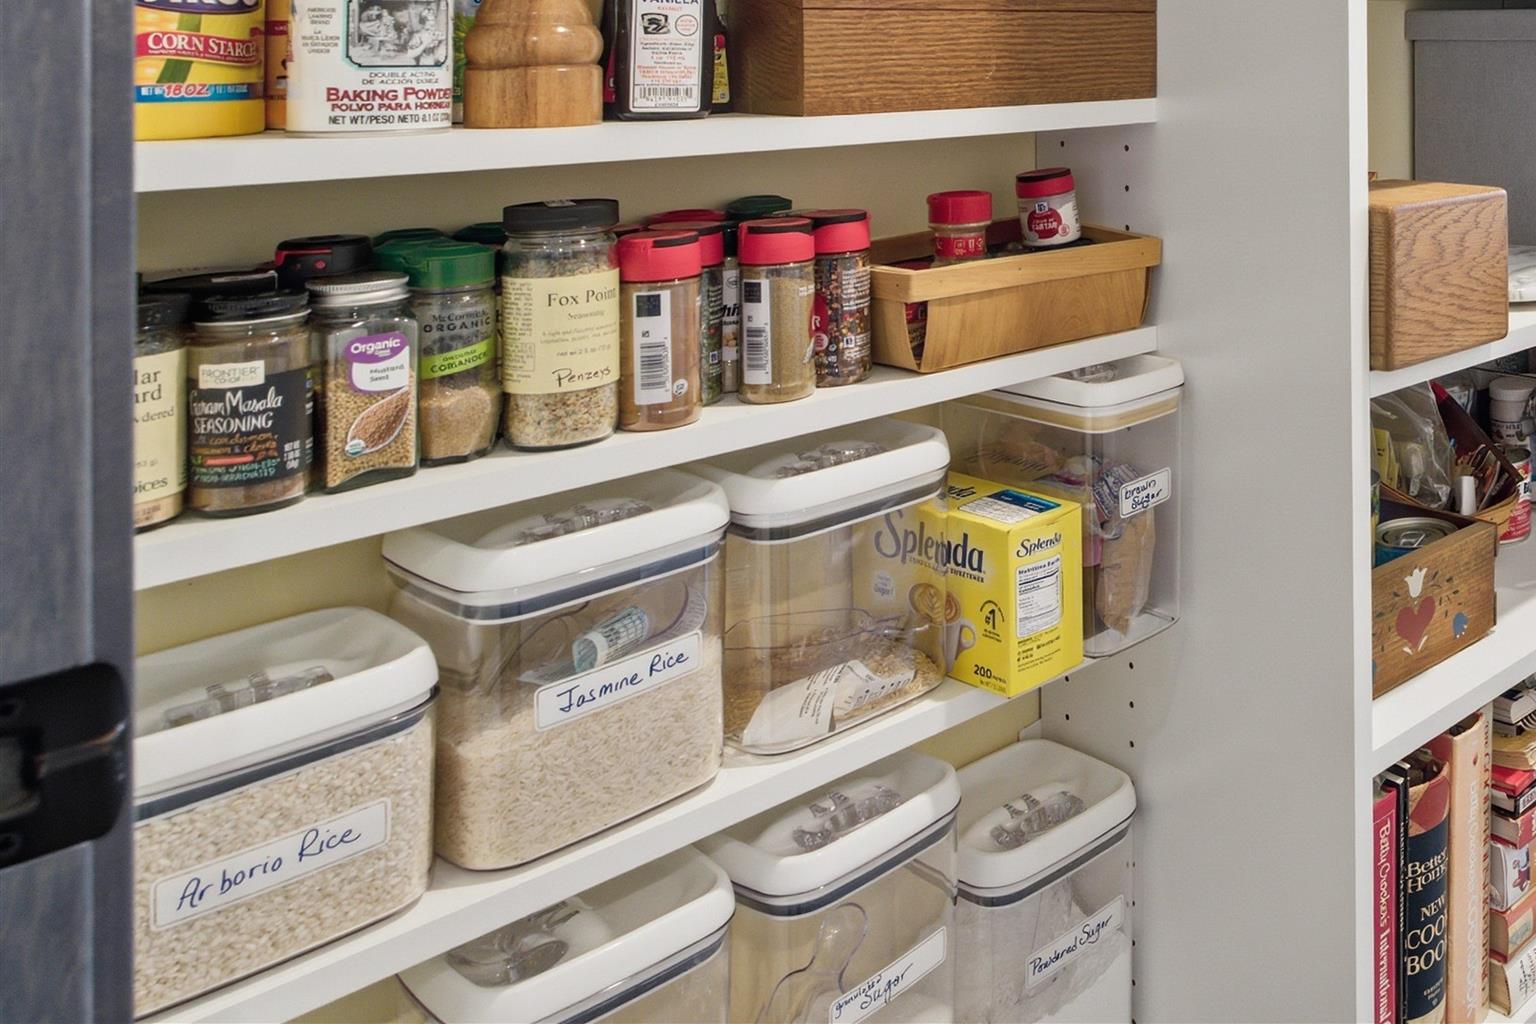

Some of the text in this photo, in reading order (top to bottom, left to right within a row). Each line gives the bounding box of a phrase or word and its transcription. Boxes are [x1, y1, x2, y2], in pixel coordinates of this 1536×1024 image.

[147, 32, 205, 51] CORN
[208, 38, 257, 58] STARCH
[165, 83, 182, 98] 18
[326, 87, 451, 102] BAKING POWDE
[328, 115, 346, 125] NET
[349, 114, 395, 125] WT/PESO
[398, 113, 419, 124] NETO
[331, 102, 375, 112] POLVO
[378, 102, 412, 112] PARA
[547, 293, 579, 307] Fox
[423, 316, 491, 333] ORGANIC
[351, 337, 401, 355] Organic
[552, 366, 612, 388] Penzeys
[225, 386, 283, 415] Masala
[194, 412, 274, 434] SEASONING
[1016, 532, 1062, 558] Splenda
[557, 647, 690, 713] Jasmine Rice
[974, 664, 992, 680] 200
[176, 824, 361, 911] Arborio Rice
[1375, 819, 1391, 1019] Betty Crocker's International
[1407, 910, 1447, 949] COO
[1028, 913, 1113, 977] Powdered Sugar
[1407, 935, 1447, 976] BOO
[860, 962, 914, 1007] Sugar
